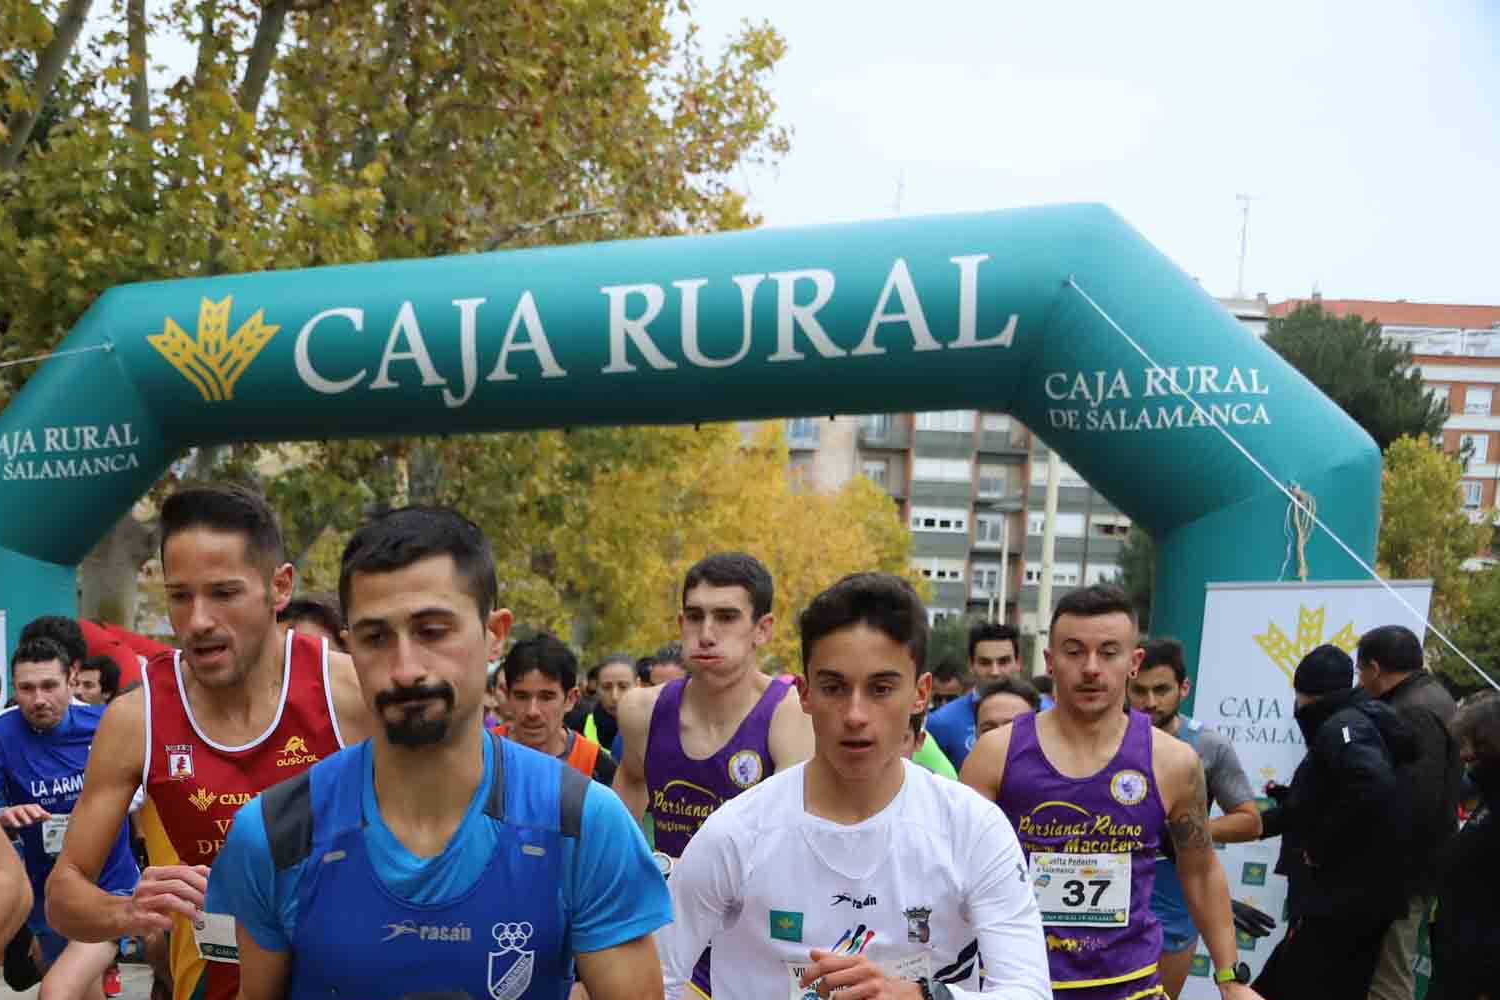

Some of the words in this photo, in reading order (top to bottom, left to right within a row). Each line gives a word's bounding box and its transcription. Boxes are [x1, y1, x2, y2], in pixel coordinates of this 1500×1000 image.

[294, 290, 567, 408] CAJA
[600, 253, 1019, 374] RURAL
[1045, 368, 1132, 408] CAJA
[1143, 364, 1269, 397] RURAL
[1050, 410, 1080, 430] DE
[1085, 403, 1271, 431] SALAMANCA
[44, 423, 140, 452] RURAL
[3, 453, 140, 481] SALAMANCA
[1219, 697, 1282, 724] CAJA
[1245, 726, 1303, 745] SALA
[30, 780, 49, 798] LA
[52, 773, 85, 796] ARM
[219, 792, 252, 806] CAJA
[1018, 815, 1088, 837] Persianas
[1089, 815, 1143, 837] Ruano
[1062, 879, 1111, 907] 37
